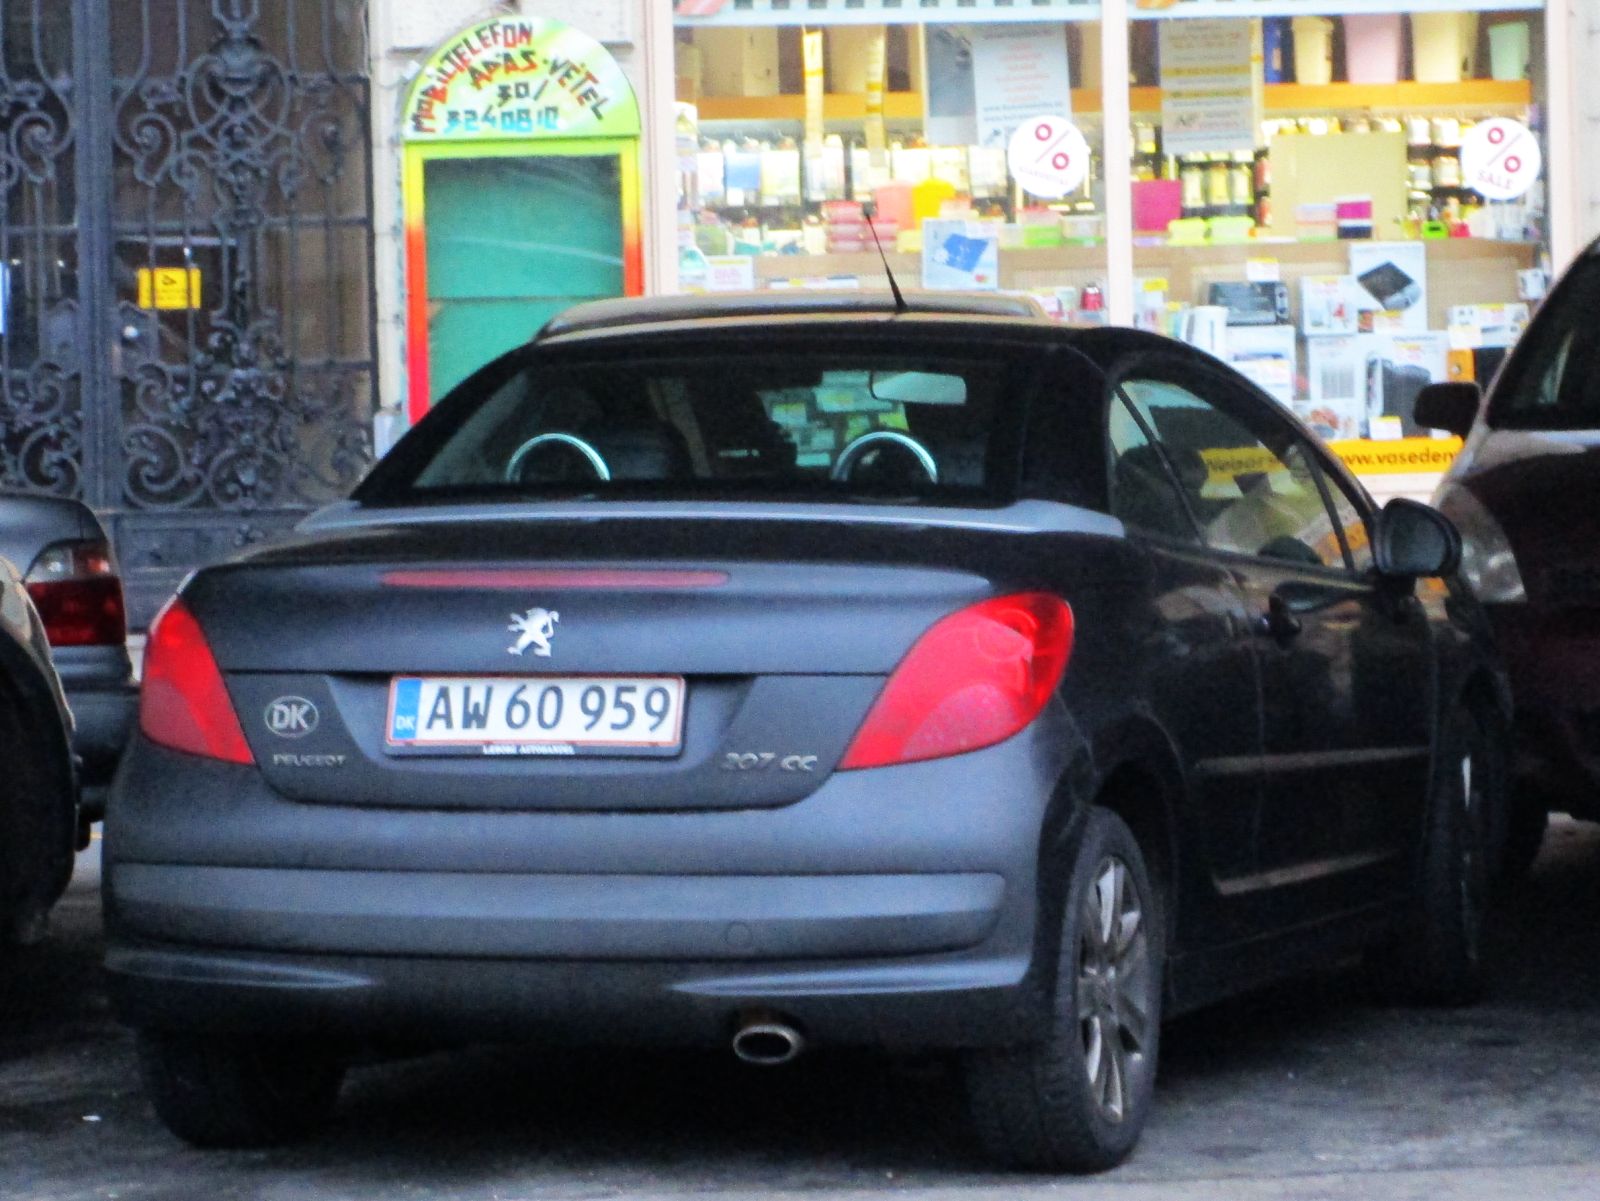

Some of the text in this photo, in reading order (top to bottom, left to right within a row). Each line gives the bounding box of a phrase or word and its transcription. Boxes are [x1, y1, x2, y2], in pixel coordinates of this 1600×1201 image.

[1477, 169, 1513, 190] SALE
[272, 703, 309, 730] DK
[426, 684, 671, 732] AW 60 959
[395, 715, 415, 731] DK
[272, 753, 347, 767] PEUGEOT
[721, 751, 777, 770] 207
